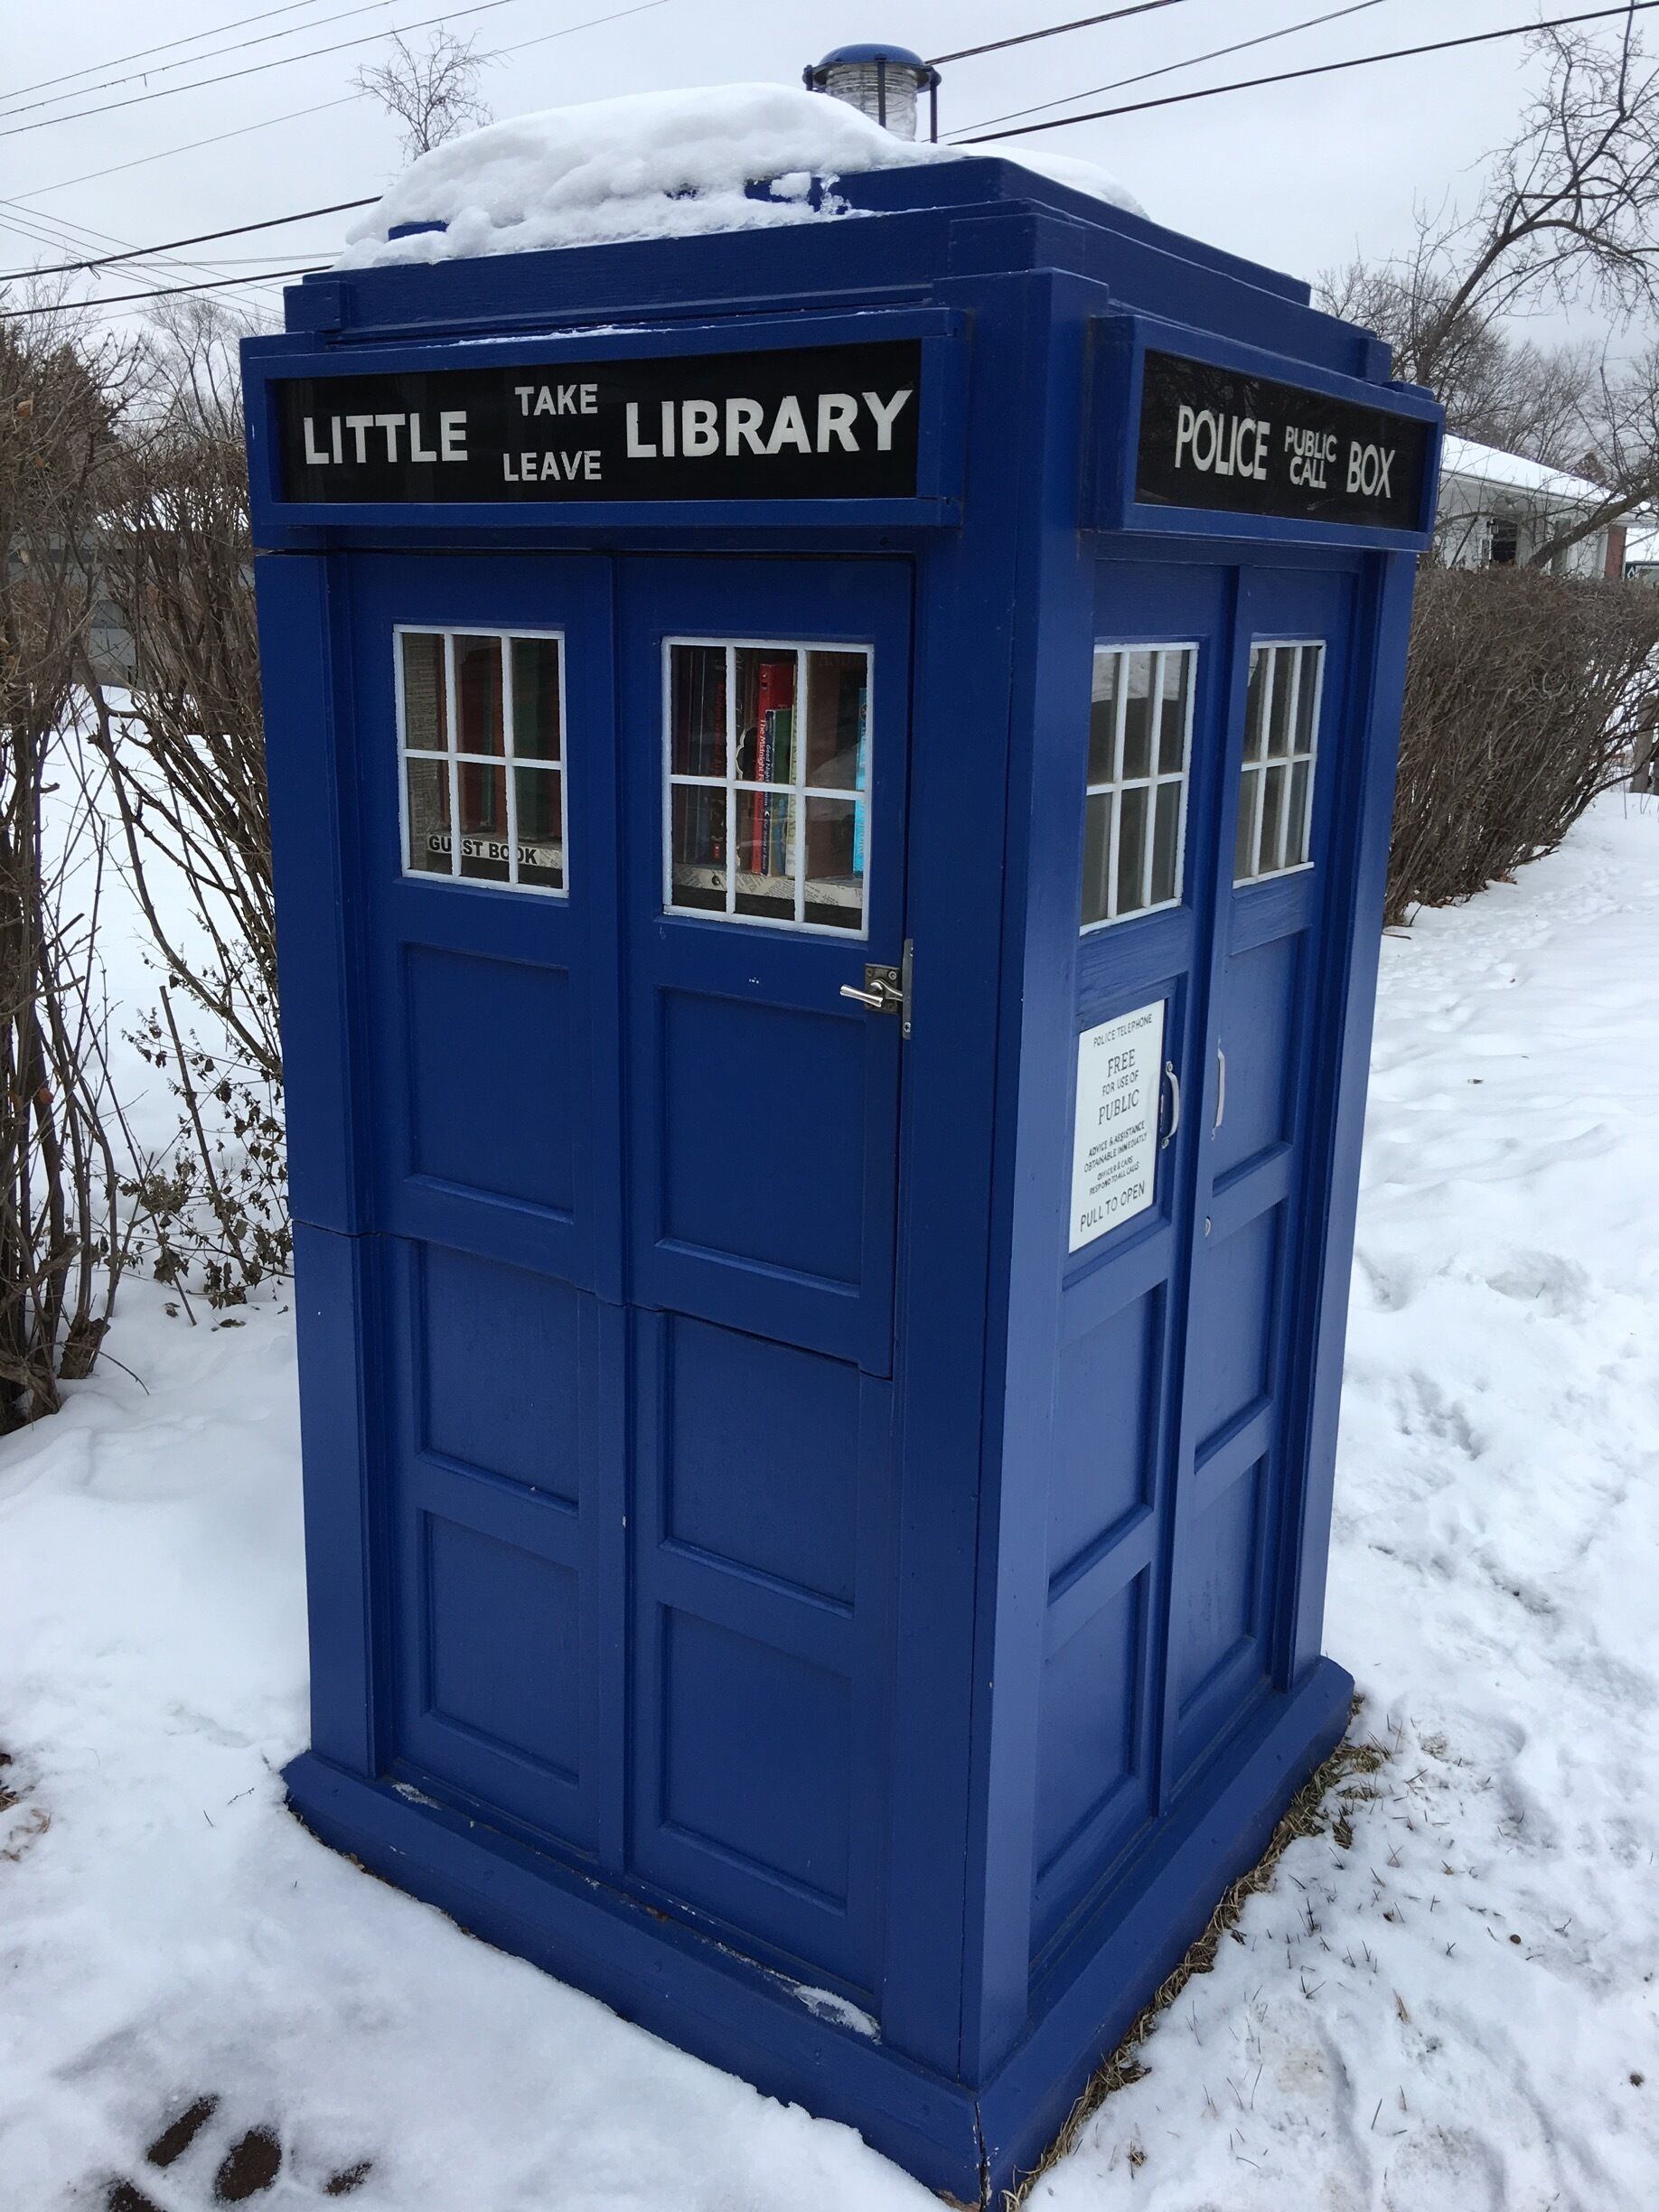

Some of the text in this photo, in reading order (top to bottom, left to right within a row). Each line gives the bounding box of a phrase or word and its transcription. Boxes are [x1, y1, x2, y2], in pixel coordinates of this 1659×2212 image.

[515, 383, 597, 416] TAKE
[304, 389, 914, 464] LITTLE LIBRARY
[1175, 405, 1395, 498] POLICE BOX
[1284, 426, 1337, 463] PUBLIC
[503, 450, 602, 481] LEAVE
[1289, 456, 1326, 489] CALL
[428, 834, 483, 856] GUST
[1093, 1013, 1152, 1047] POLICE TELEPHONE
[1107, 1049, 1136, 1078] FREE
[1101, 1070, 1139, 1097] FOR USE OF
[1098, 1089, 1139, 1126] PUBLIC
[1088, 1120, 1145, 1158] ADVICE & ASSISTANCE
[1083, 1148, 1117, 1173] OBTAINABLE
[1089, 1177, 1111, 1195] RESPOND
[1117, 1171, 1127, 1180] ALL
[1126, 1161, 1139, 1176] CALLS
[1080, 1180, 1145, 1233] PULL TO OPEN
